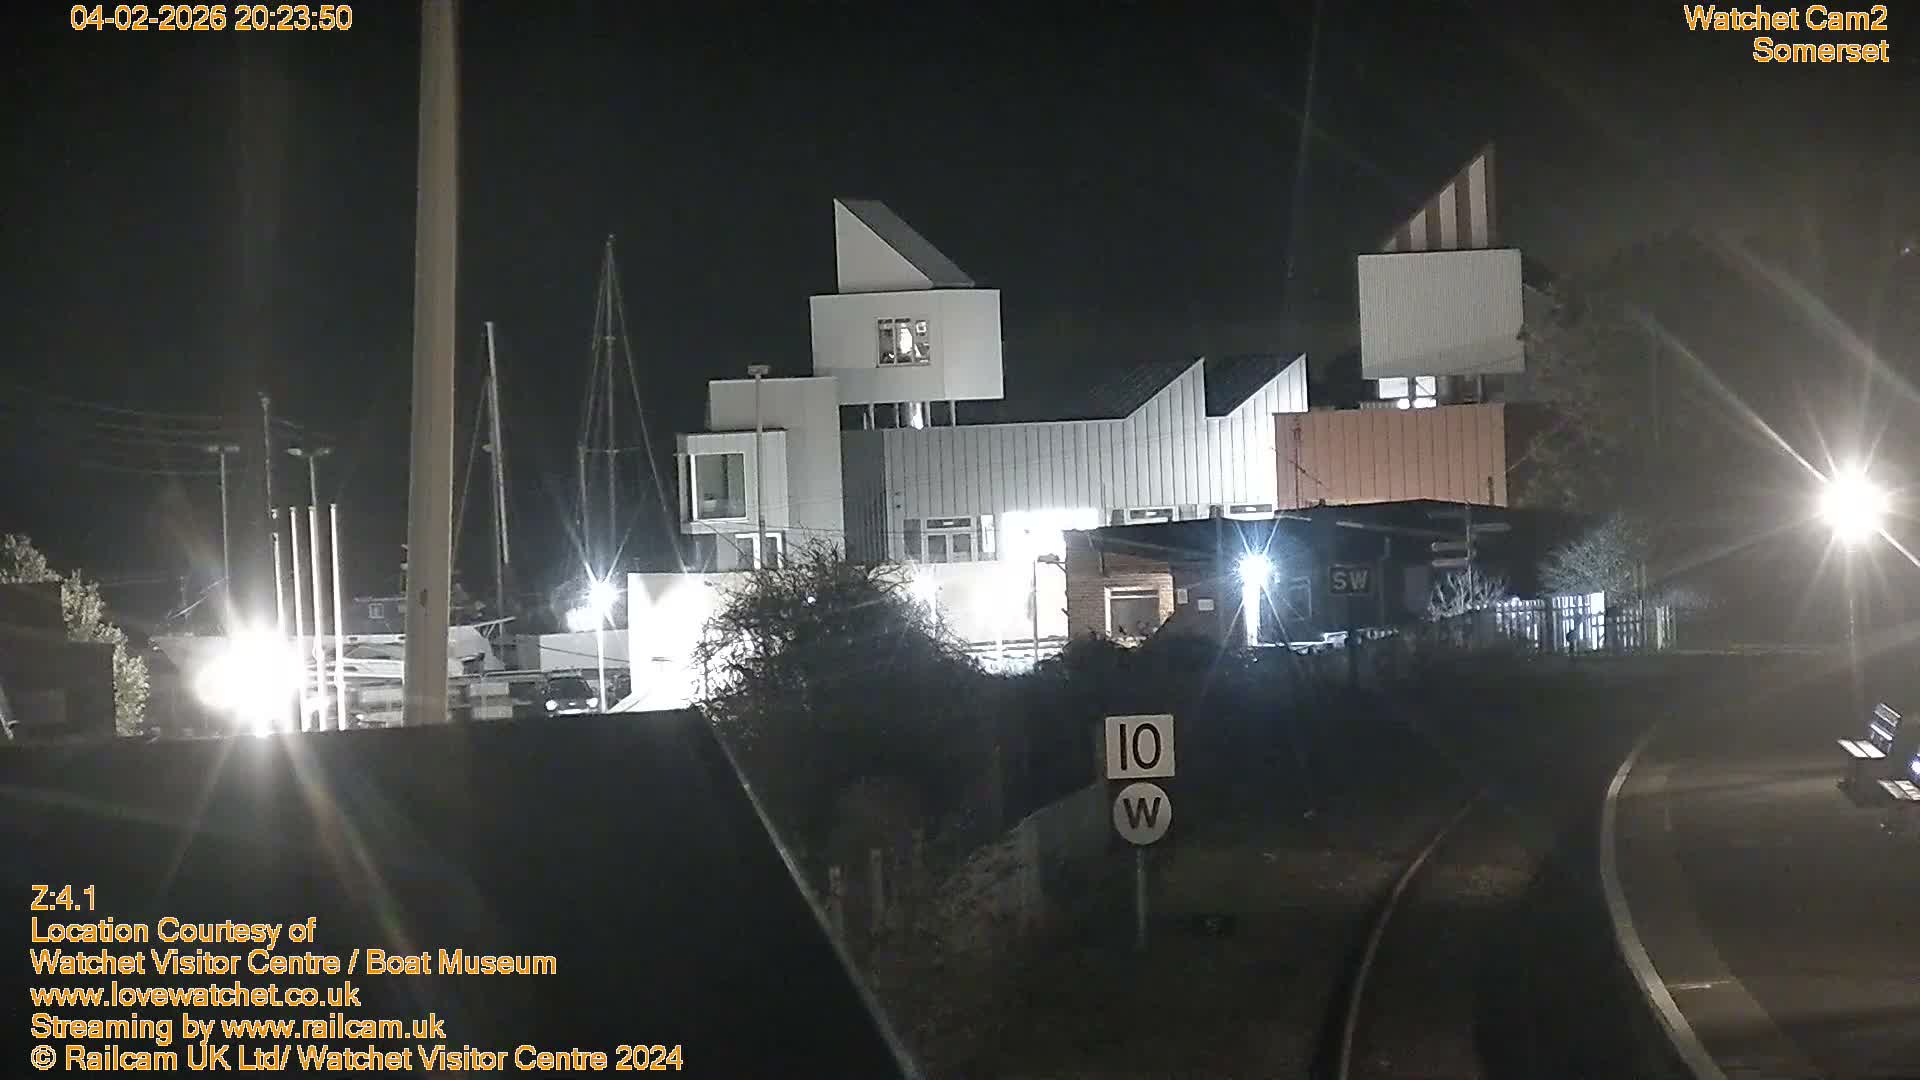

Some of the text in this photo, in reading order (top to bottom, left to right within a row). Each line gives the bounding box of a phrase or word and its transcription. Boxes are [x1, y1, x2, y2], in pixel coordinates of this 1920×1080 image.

[1332, 569, 1368, 590] SW
[1119, 722, 1161, 771] 10
[1122, 796, 1161, 829] W
